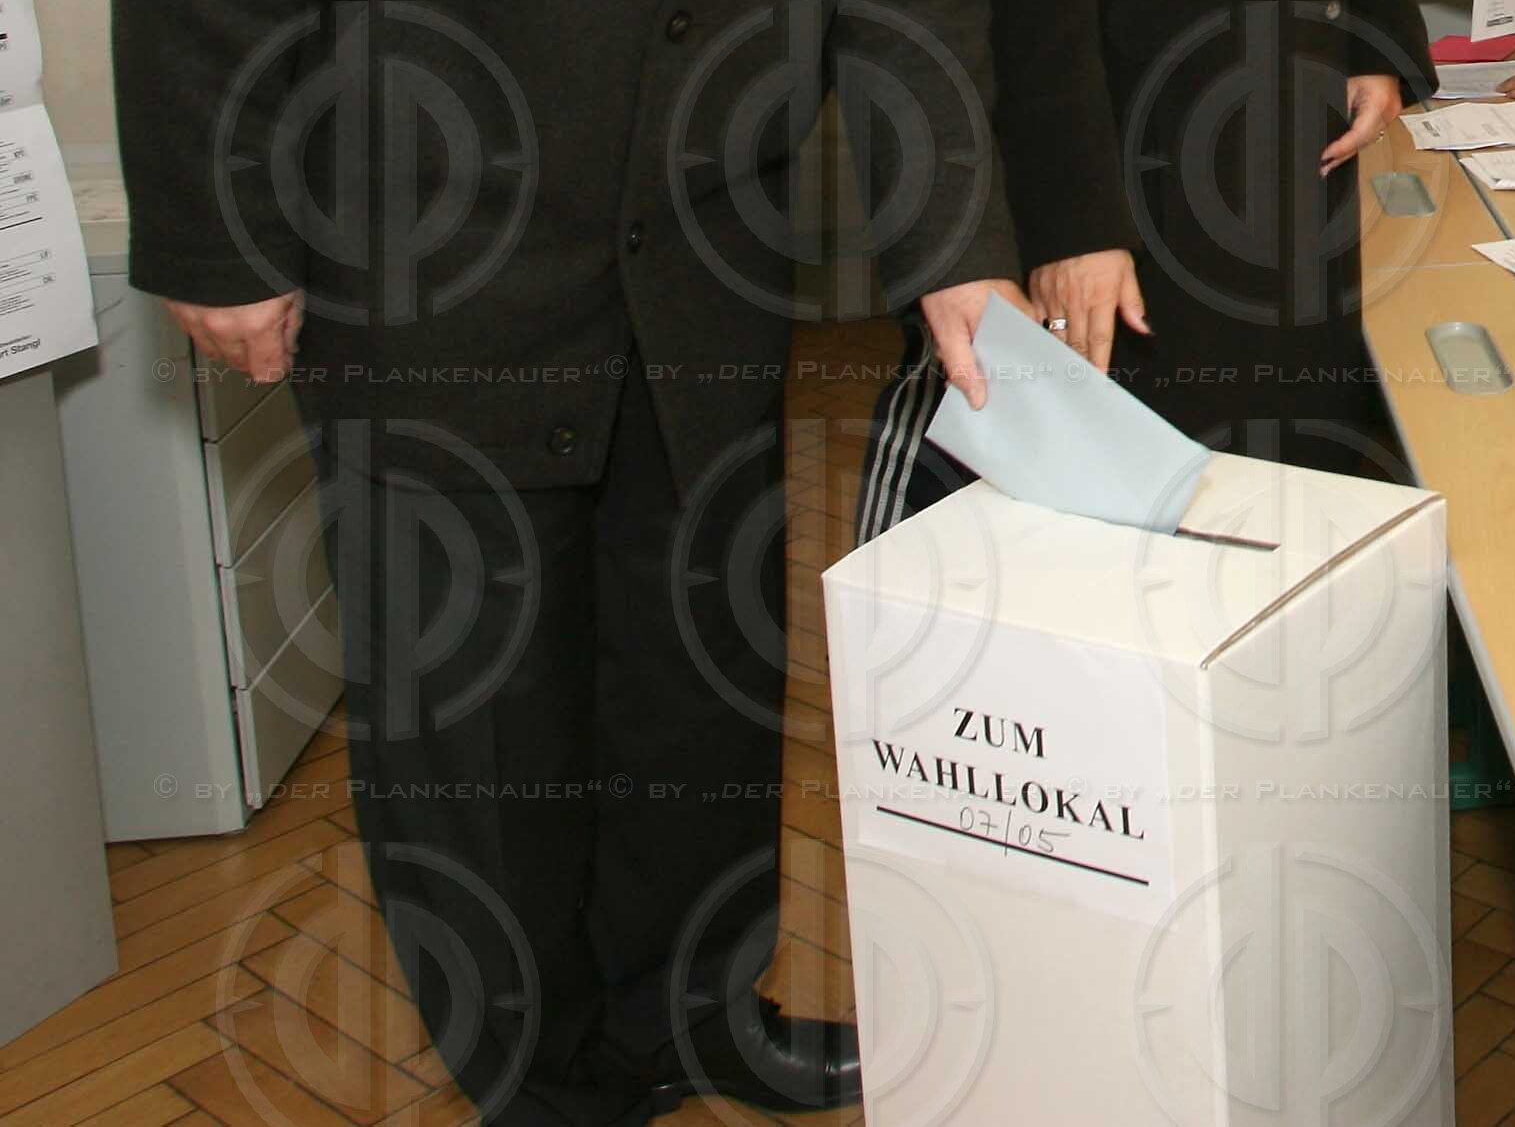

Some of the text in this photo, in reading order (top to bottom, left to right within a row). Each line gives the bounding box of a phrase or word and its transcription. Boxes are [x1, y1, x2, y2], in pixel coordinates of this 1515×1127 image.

[953, 707, 1048, 758] ZUM
[872, 738, 1146, 840] WAHLLOKAL
[960, 806, 1071, 857] 07/05
